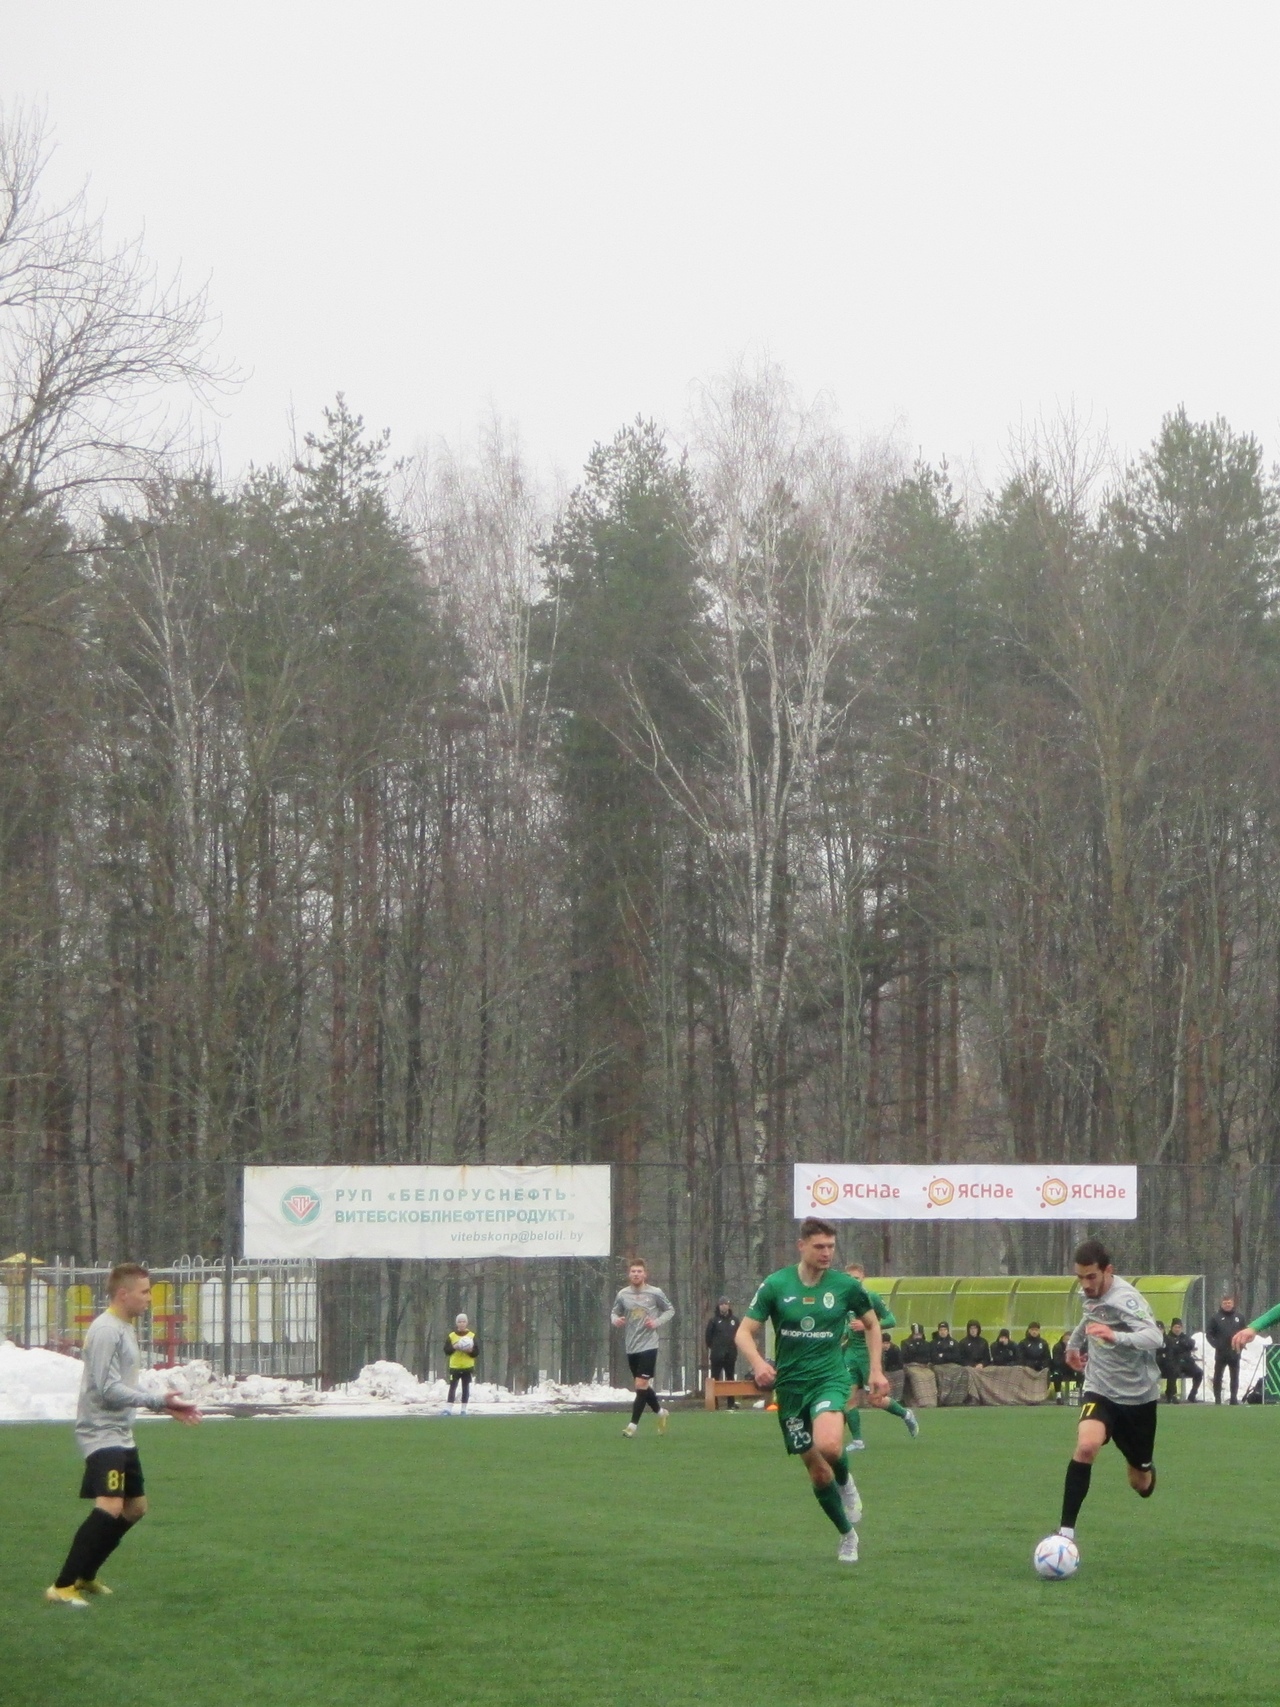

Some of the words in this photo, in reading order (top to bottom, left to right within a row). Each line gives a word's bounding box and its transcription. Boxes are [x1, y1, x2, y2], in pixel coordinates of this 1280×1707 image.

[335, 1188, 373, 1202] РУП
[819, 1186, 833, 1195] TV
[934, 1187, 949, 1196] TV
[1049, 1187, 1062, 1196] TV
[334, 1208, 576, 1224] ВИТЕБСКОБЛНЕФТЕПРОДУКТ»
[790, 1430, 812, 1449] 25
